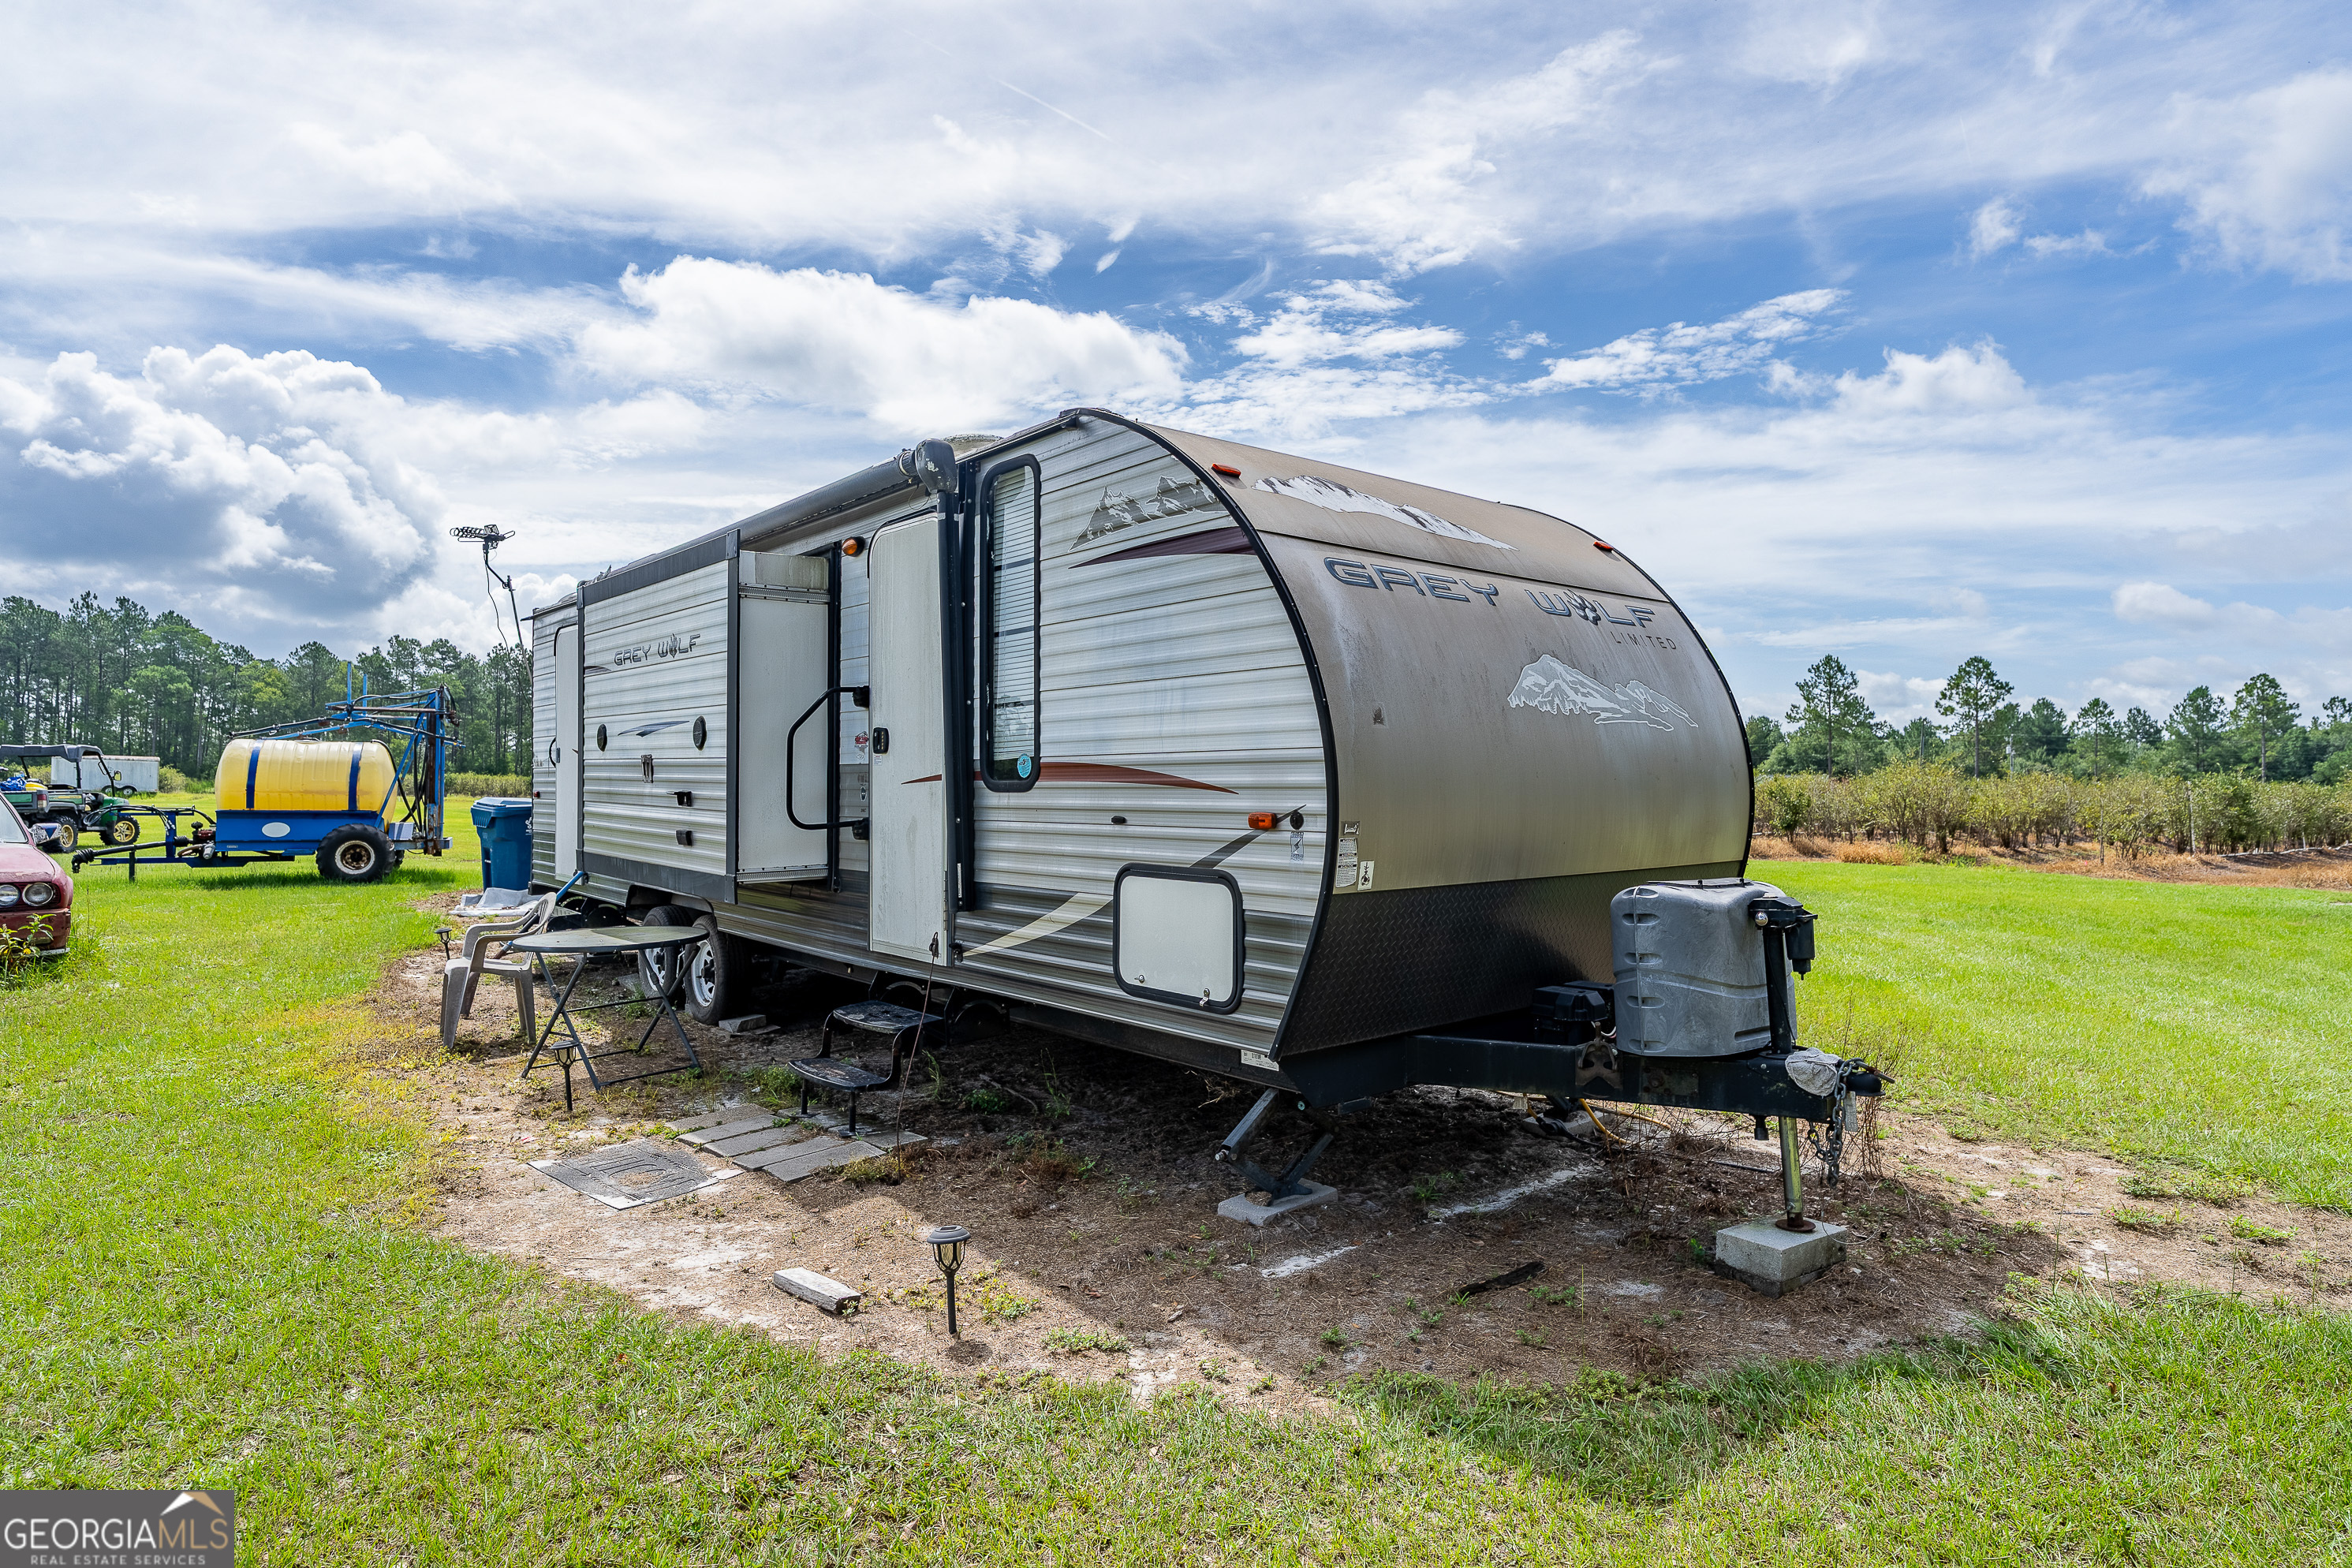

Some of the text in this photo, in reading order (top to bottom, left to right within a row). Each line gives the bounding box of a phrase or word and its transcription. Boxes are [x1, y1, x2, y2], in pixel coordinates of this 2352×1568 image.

[1323, 557, 1499, 607] GREY
[1610, 631, 1677, 650] LIMITED
[614, 644, 651, 666] GREY
